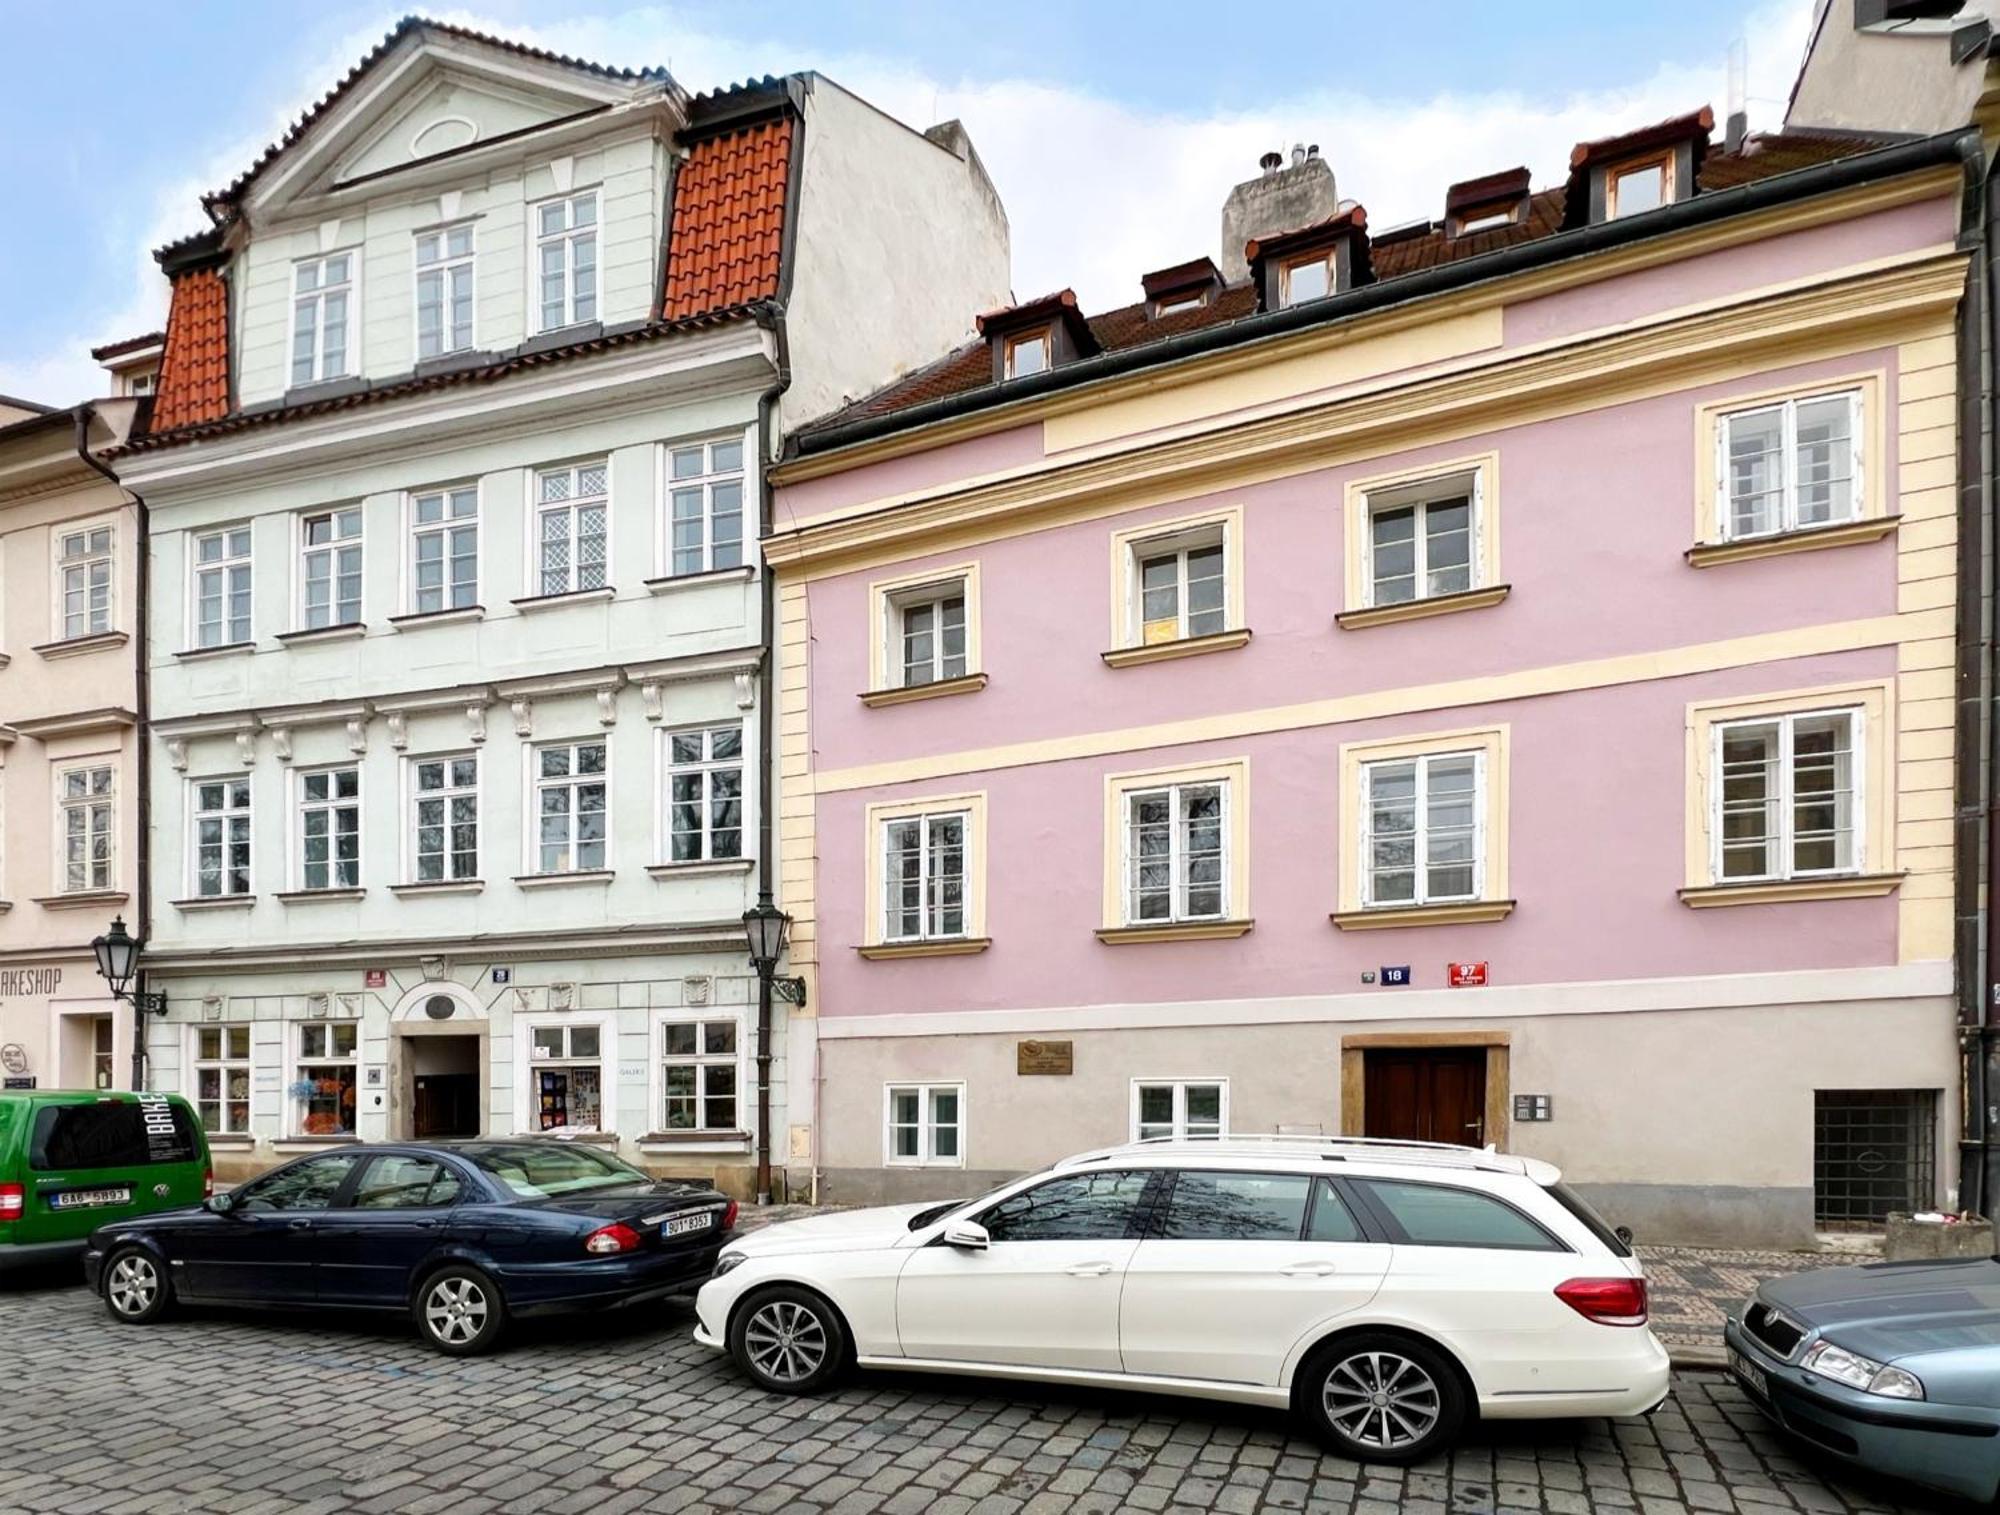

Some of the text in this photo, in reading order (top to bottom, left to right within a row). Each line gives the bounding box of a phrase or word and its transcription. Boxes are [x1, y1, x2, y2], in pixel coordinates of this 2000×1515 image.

[1387, 970, 1402, 982] 18
[1460, 965, 1476, 976] 97
[0, 968, 62, 996] AKESHOP
